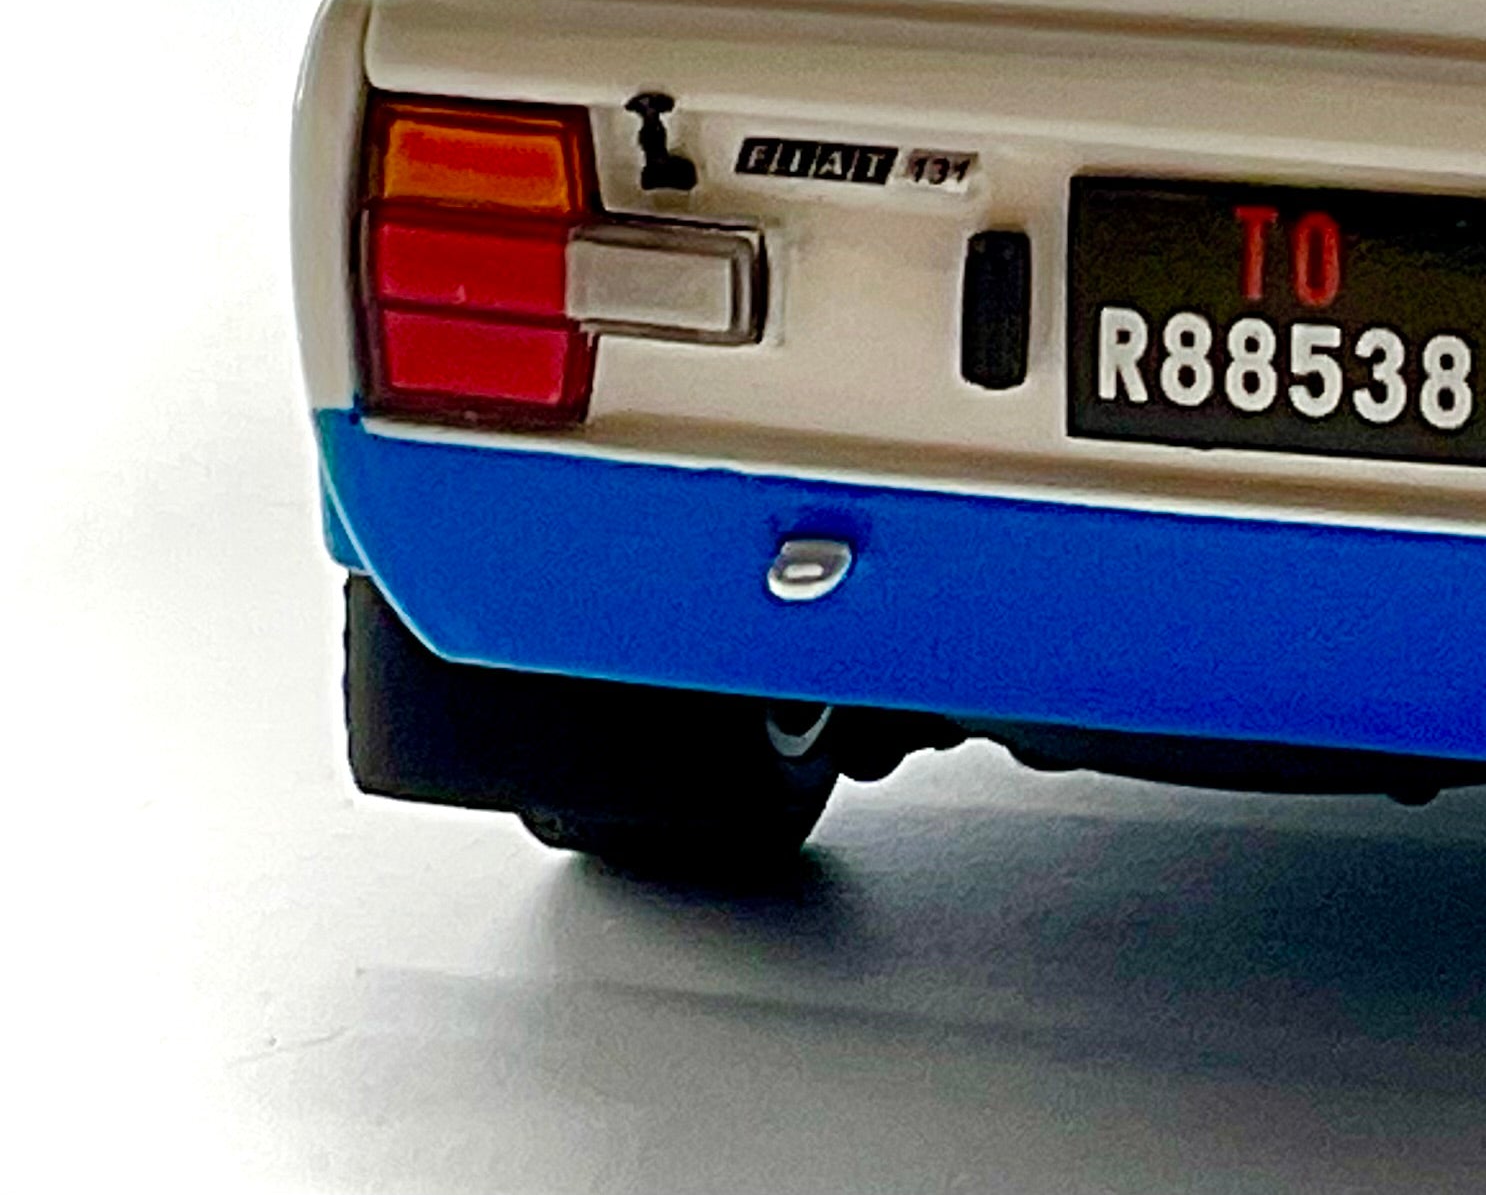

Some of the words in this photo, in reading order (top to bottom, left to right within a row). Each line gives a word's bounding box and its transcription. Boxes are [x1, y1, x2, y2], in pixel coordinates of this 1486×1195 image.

[741, 141, 892, 181] FIAT
[910, 156, 972, 186] 131
[1097, 305, 1475, 431] R88538
